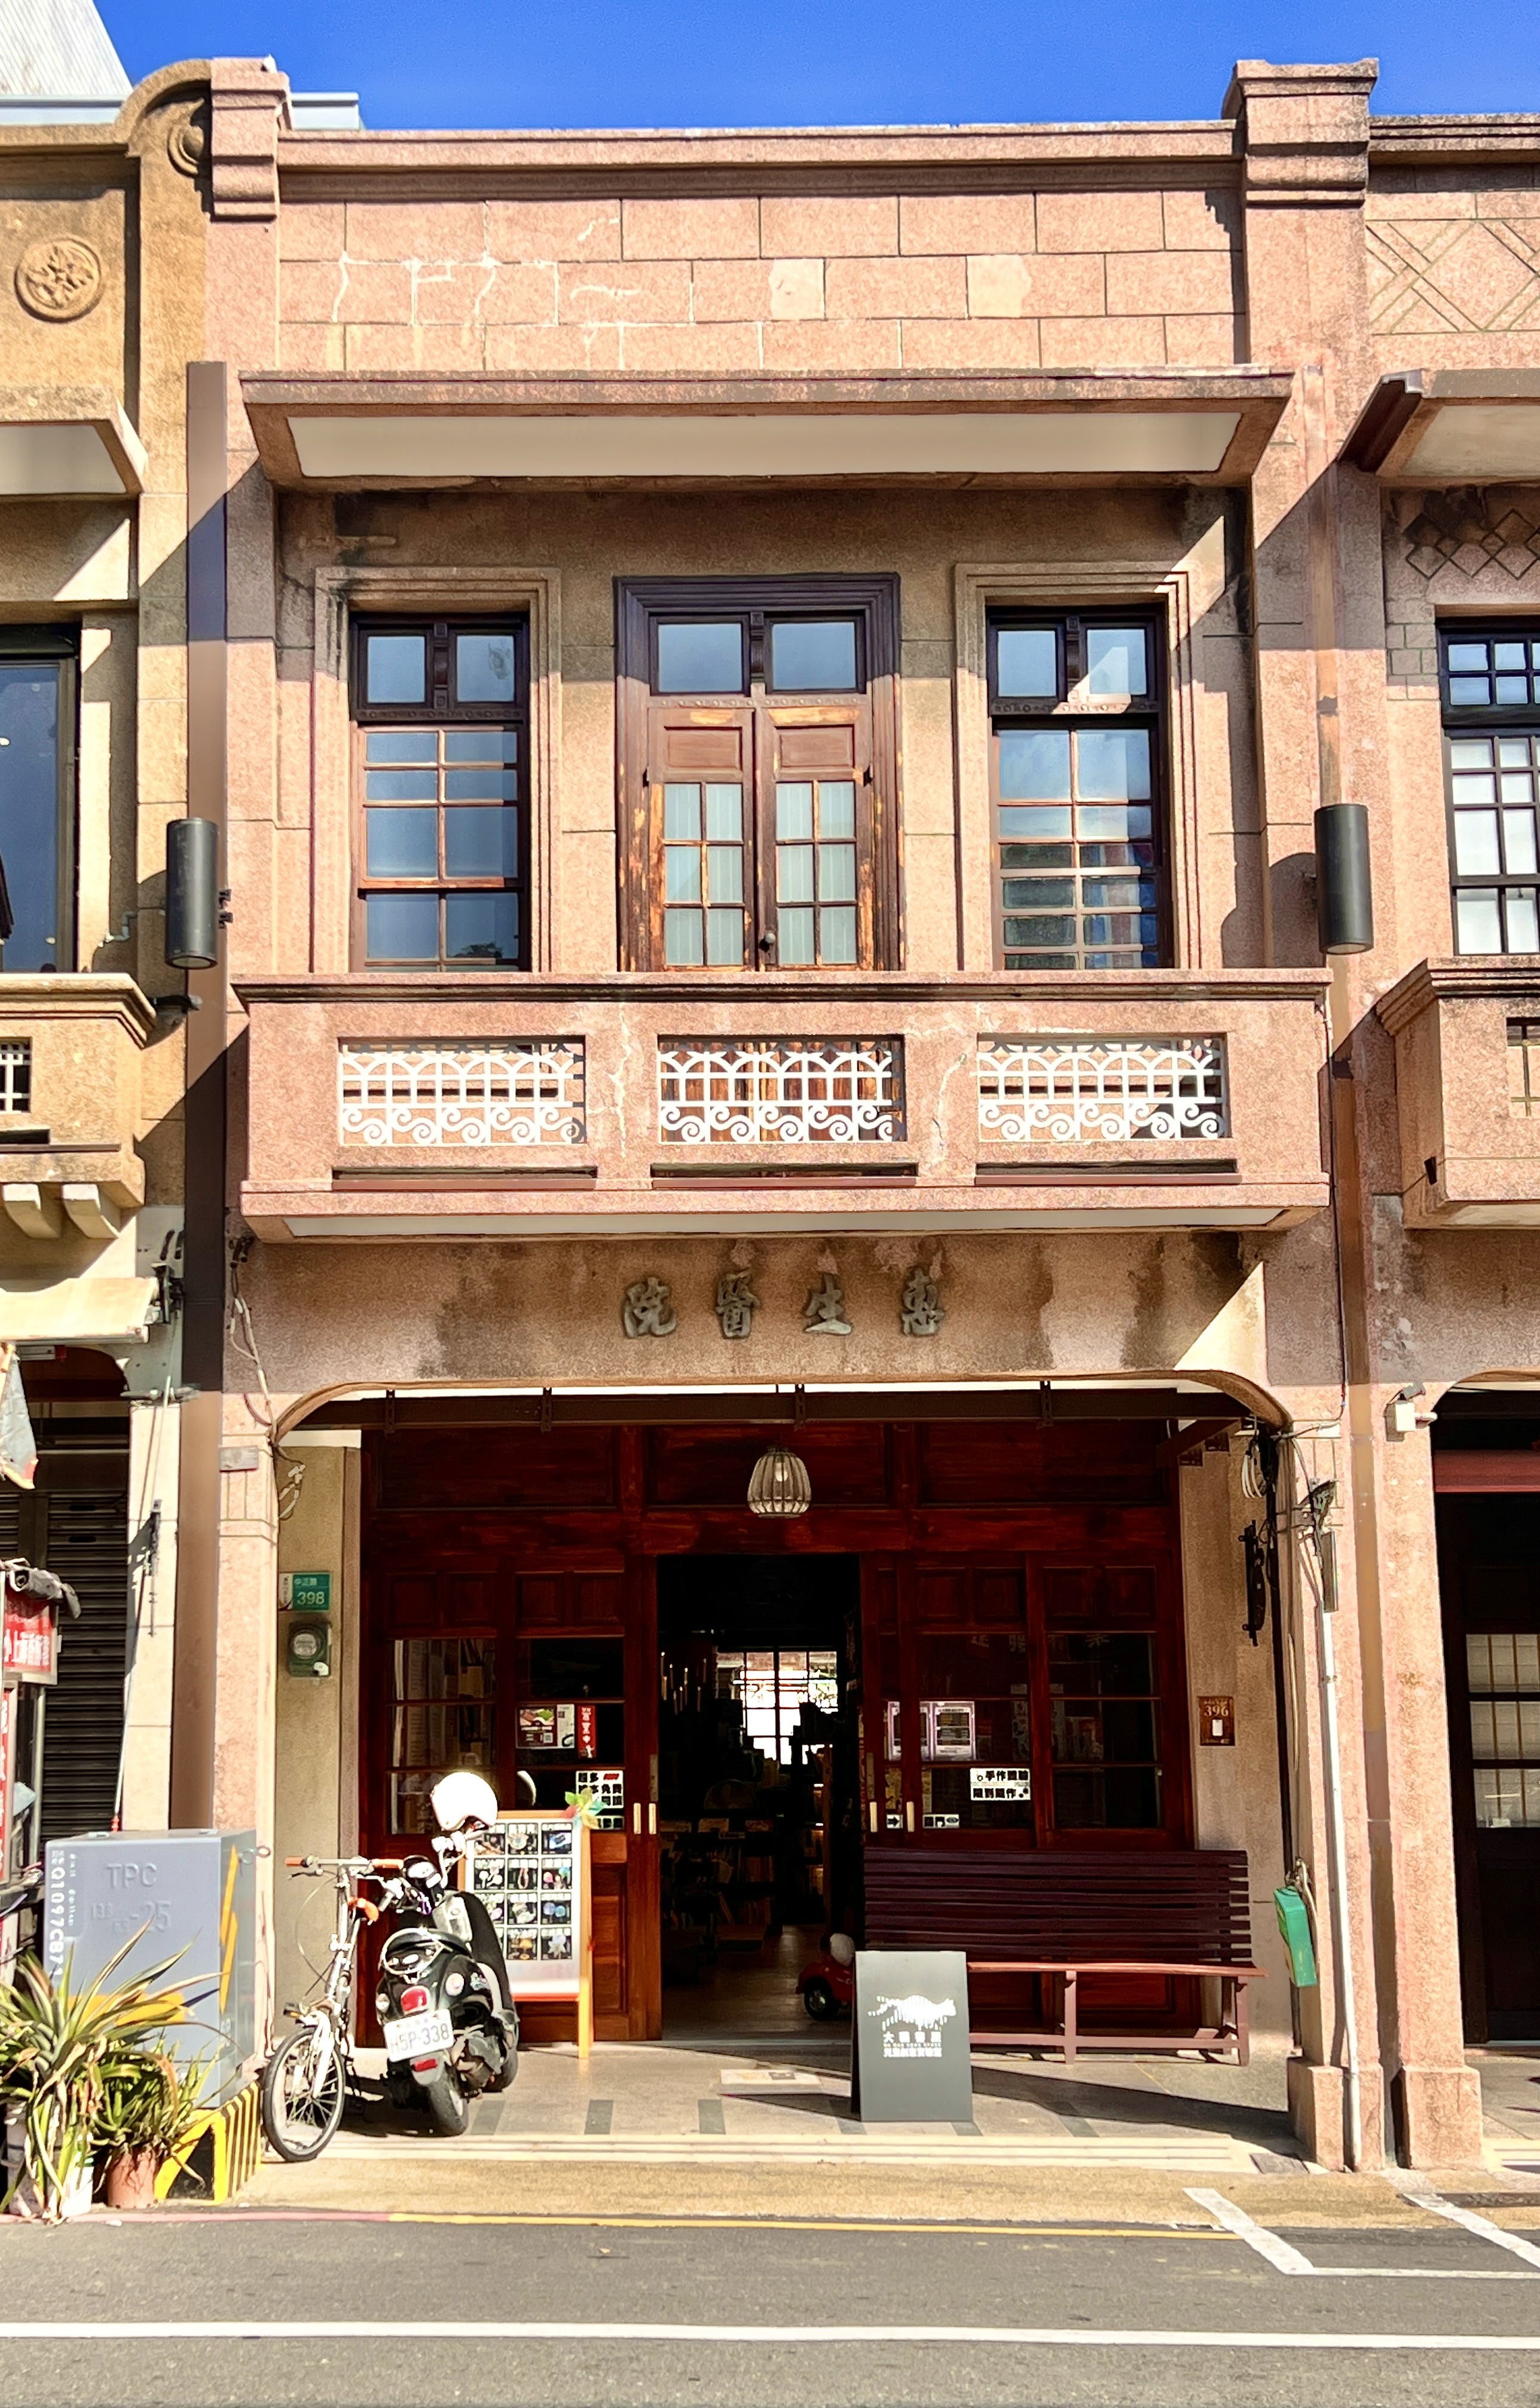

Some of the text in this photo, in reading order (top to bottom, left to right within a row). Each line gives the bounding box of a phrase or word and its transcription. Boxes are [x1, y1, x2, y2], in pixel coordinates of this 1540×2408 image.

[297, 1591, 325, 1605] 398
[1203, 1705, 1229, 1716] 396
[106, 1862, 158, 1889] TPC
